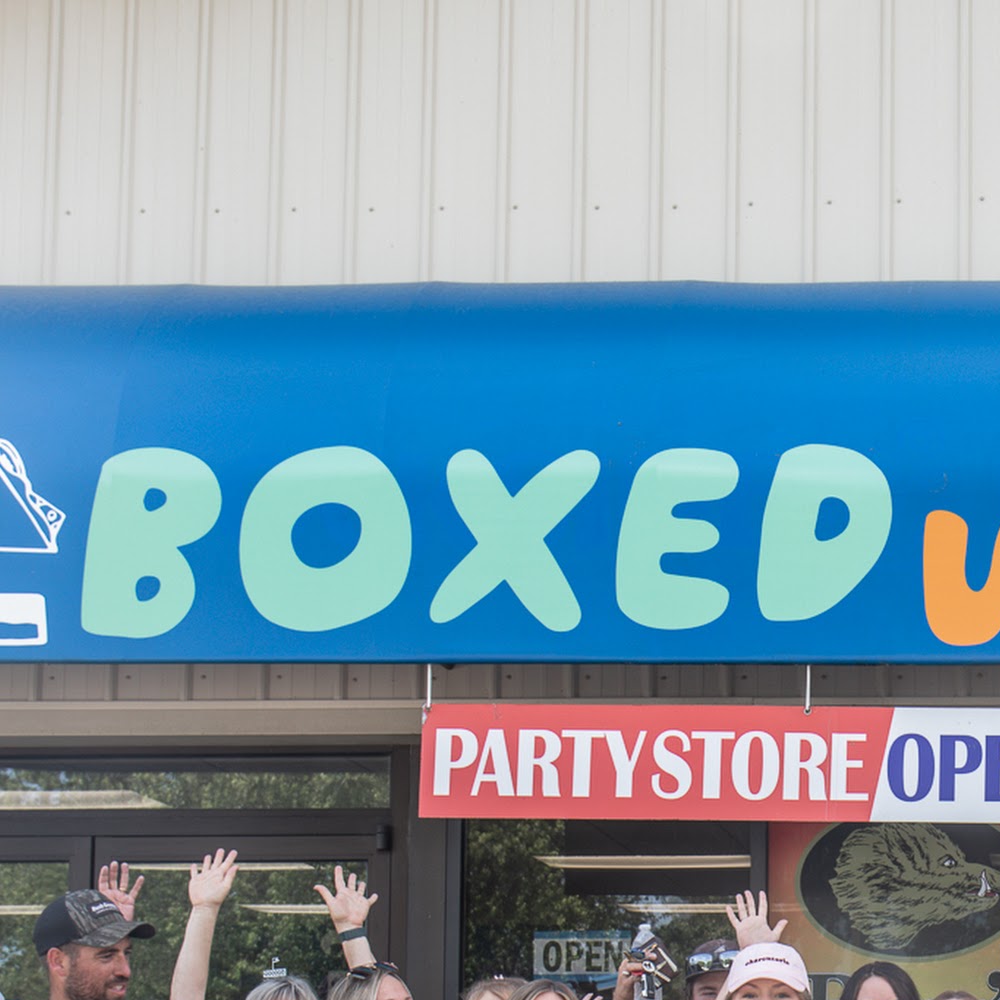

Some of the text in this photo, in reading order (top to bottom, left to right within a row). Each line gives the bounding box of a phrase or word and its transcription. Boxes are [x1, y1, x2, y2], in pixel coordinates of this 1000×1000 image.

[81, 443, 893, 638] BOXED
[433, 729, 648, 798] PARTY
[651, 729, 869, 801] STORE
[543, 940, 624, 973] OPEN
